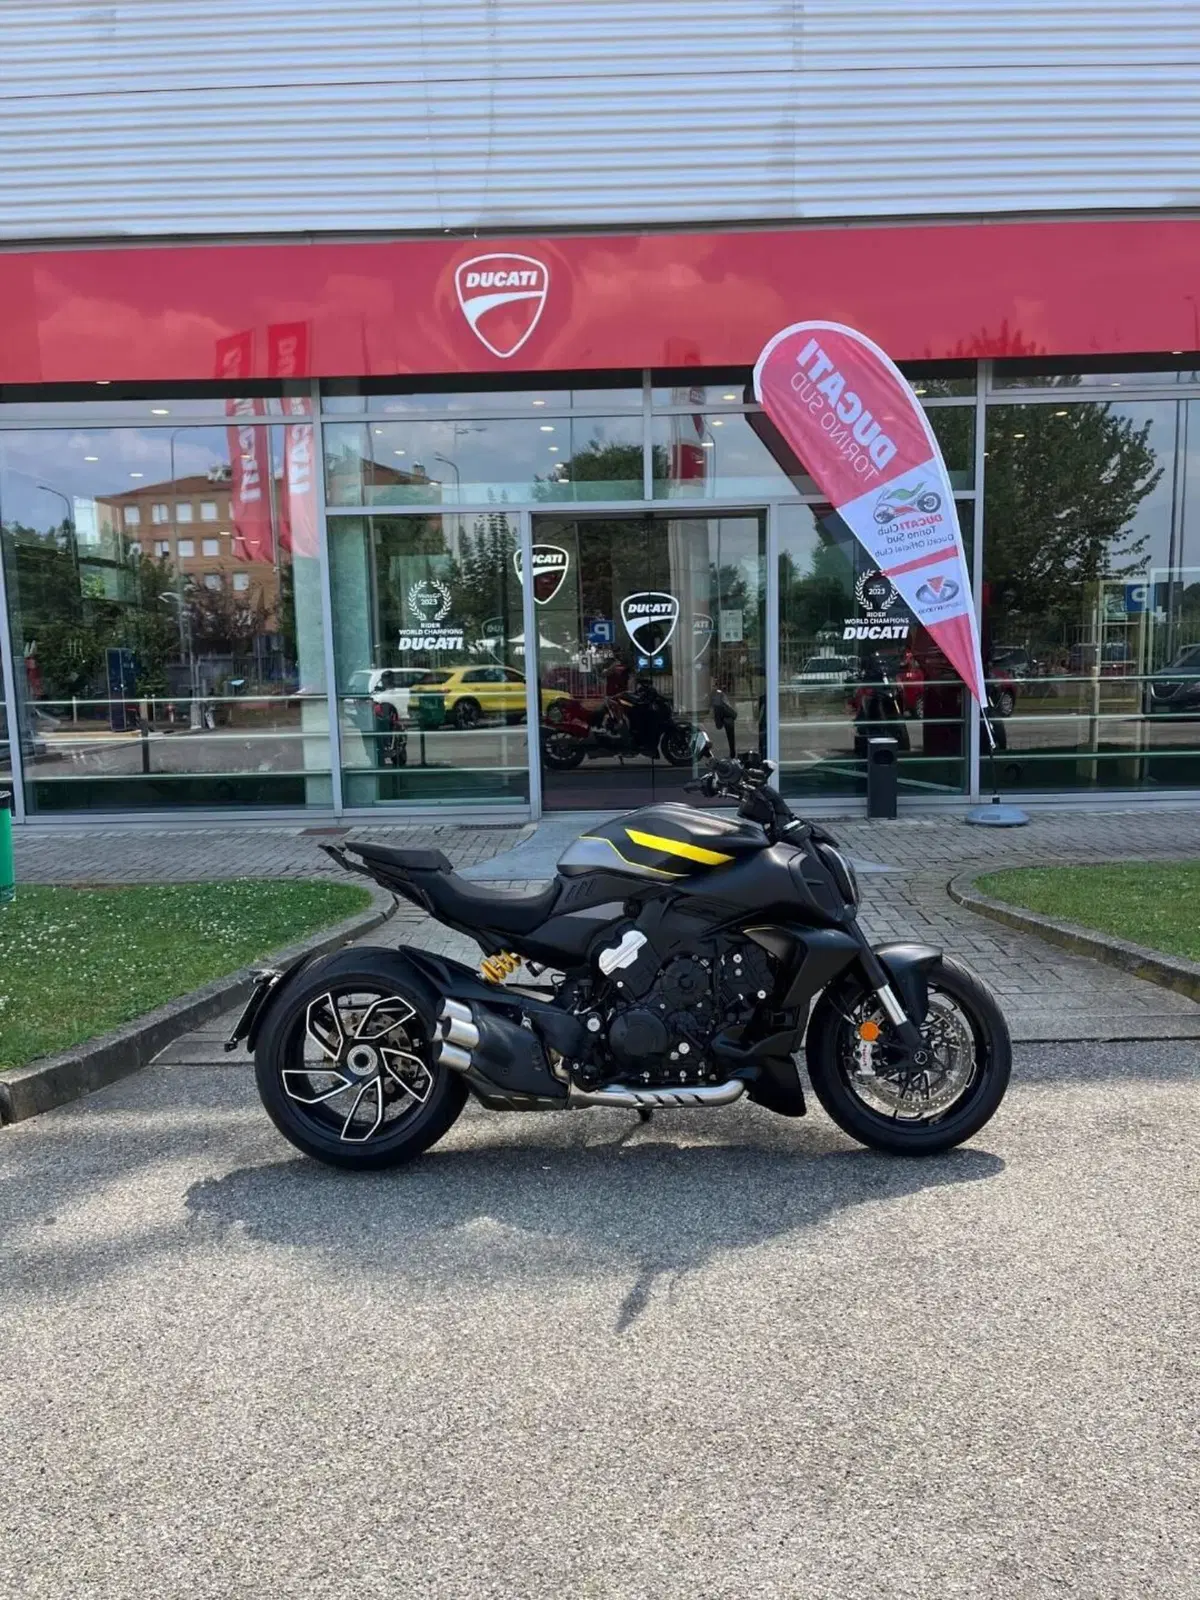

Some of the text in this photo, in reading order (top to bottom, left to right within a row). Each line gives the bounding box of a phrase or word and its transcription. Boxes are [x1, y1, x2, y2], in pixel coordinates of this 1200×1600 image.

[466, 270, 538, 288] DUCATI
[420, 598, 438, 606] 2023
[627, 603, 673, 614] DUCATI
[869, 617, 910, 625] CHAMPIONS
[842, 625, 910, 640] DUCATI
[398, 636, 464, 651] DUCATI
